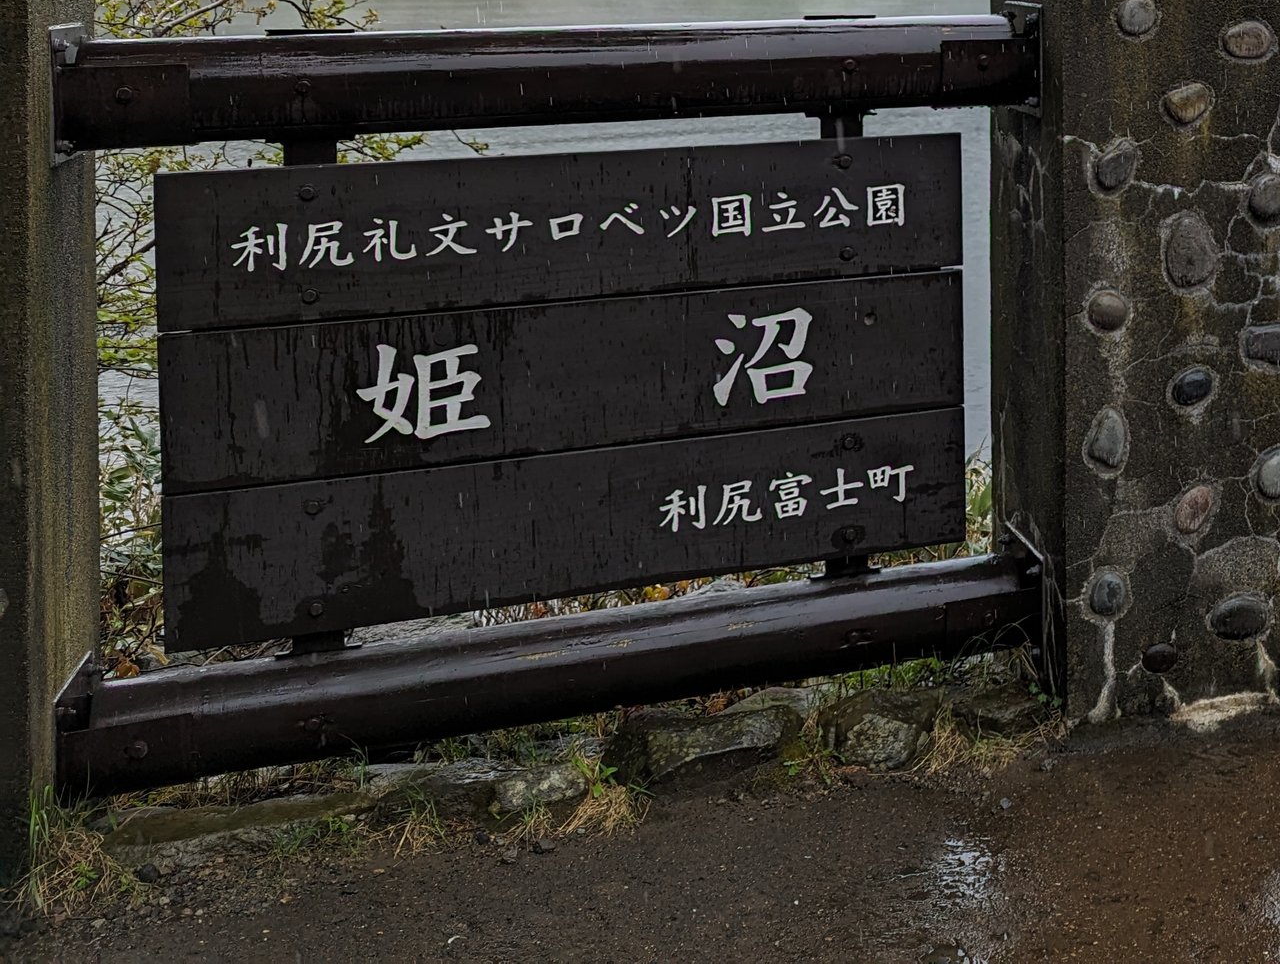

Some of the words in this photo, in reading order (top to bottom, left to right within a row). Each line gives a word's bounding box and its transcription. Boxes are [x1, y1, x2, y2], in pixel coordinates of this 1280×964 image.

[231, 184, 905, 271] 利尻礼文サロベツ国立公園
[660, 465, 914, 532] 利尻富士町
